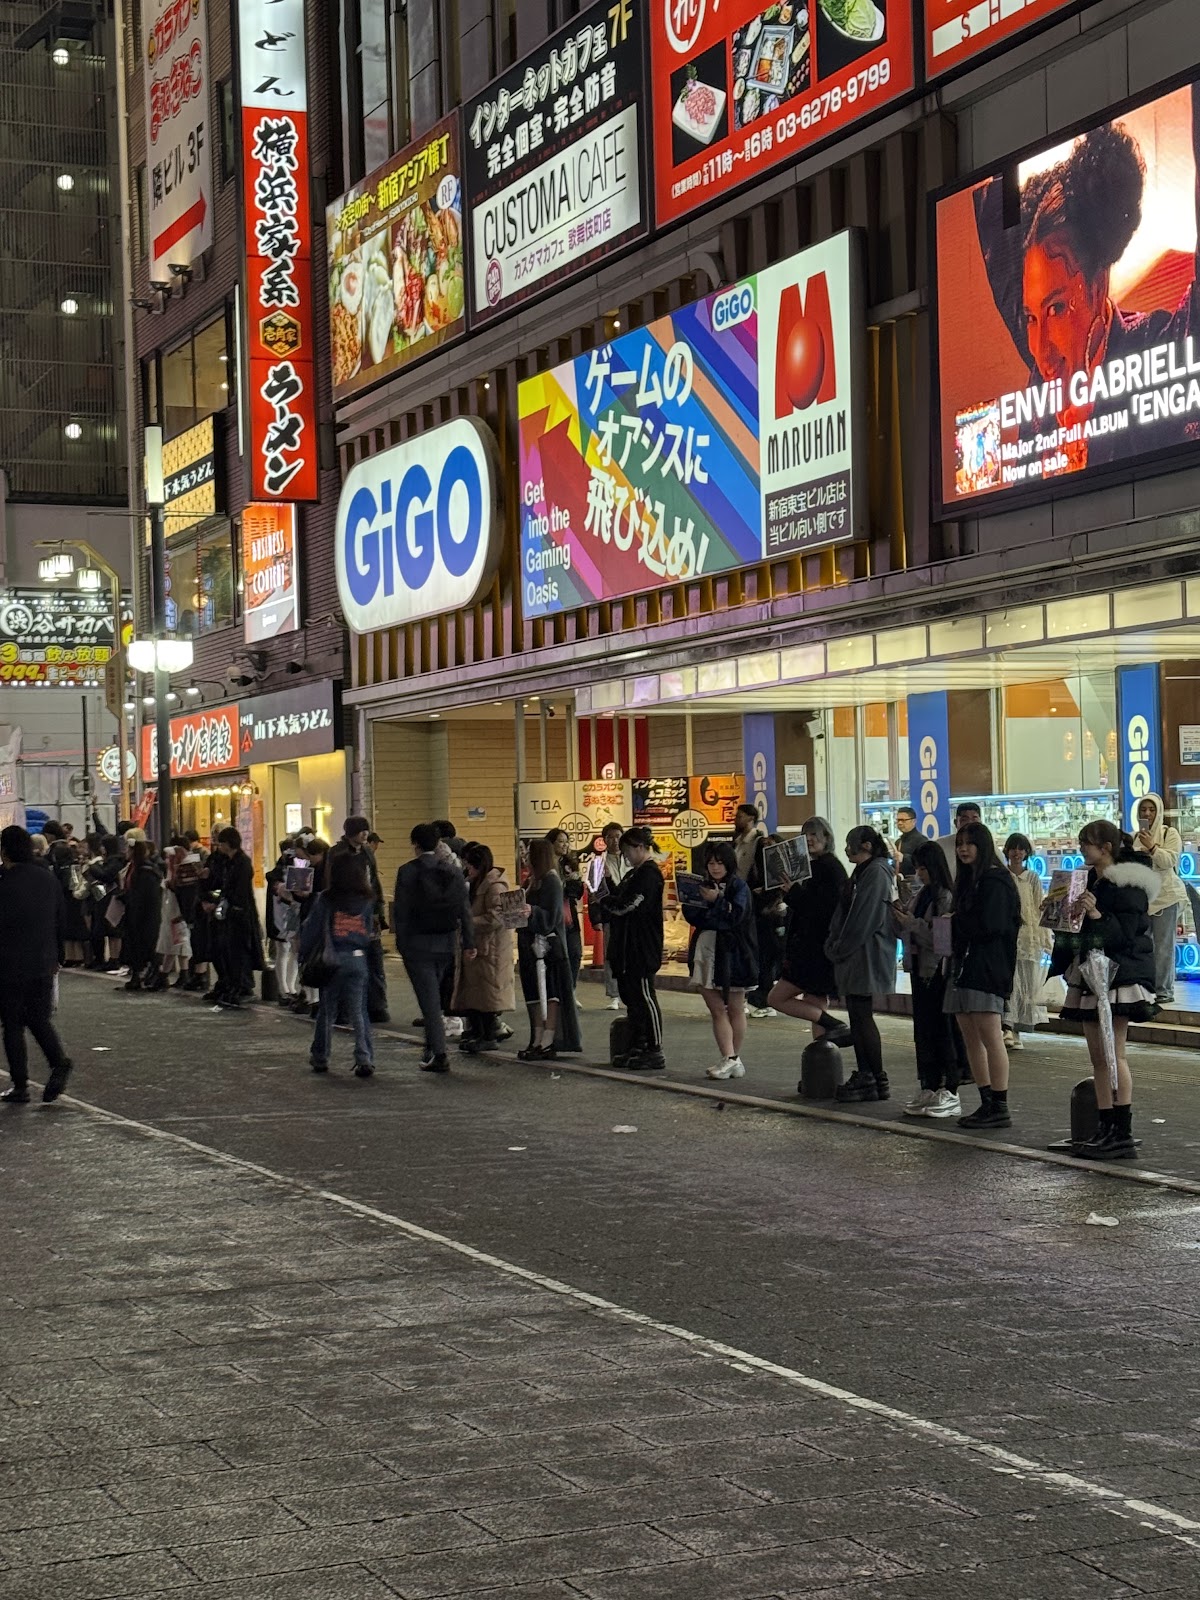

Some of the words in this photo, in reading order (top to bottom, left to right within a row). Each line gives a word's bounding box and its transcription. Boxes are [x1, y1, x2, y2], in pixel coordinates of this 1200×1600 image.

[253, 0, 297, 97] どん
[469, 22, 608, 149] インターネットカフェ
[607, 0, 634, 48] 7F
[487, 61, 617, 179] 完全個室・完全防音
[776, 57, 891, 143] 03-6278-9799
[187, 121, 205, 175] 3F
[377, 132, 450, 212] 新宿アジア横丁
[484, 162, 571, 261] CUSTOMA
[577, 124, 627, 204] CAFE
[255, 114, 300, 308] 横浜家系
[514, 239, 565, 281] カスタマカフェ
[585, 341, 694, 415] ゲームの
[1001, 378, 1062, 428] ENVii
[261, 360, 304, 495] ラーメン
[596, 409, 710, 485] オアシスに
[767, 409, 847, 475] MARUHAN
[1002, 438, 1035, 460] Major
[1035, 433, 1058, 452] 2nd
[1058, 424, 1082, 446] Full
[1083, 408, 1129, 438] ALBUM
[1003, 465, 1026, 483] Now
[1028, 461, 1042, 475] on
[1043, 453, 1068, 472] sale
[524, 478, 545, 506] Get
[768, 479, 847, 522] 新宿東宝ビル店は
[528, 516, 549, 539] into
[551, 505, 570, 532] the
[584, 465, 710, 580] 飛び込め!
[769, 506, 848, 547] 当ビル向い側です
[526, 542, 571, 574] Gaming
[527, 578, 559, 607] Oasis
[254, 708, 332, 741] 山下本気うどん
[587, 784, 618, 792] カラオケ
[633, 778, 687, 788] インターネット
[648, 788, 687, 798] &コミック
[530, 800, 562, 811] TOA
[675, 819, 689, 828] 04
[691, 819, 706, 828] 05
[576, 822, 591, 832] 03
[577, 833, 589, 843] 07
[676, 829, 690, 839] RF
[692, 829, 704, 839] B1
